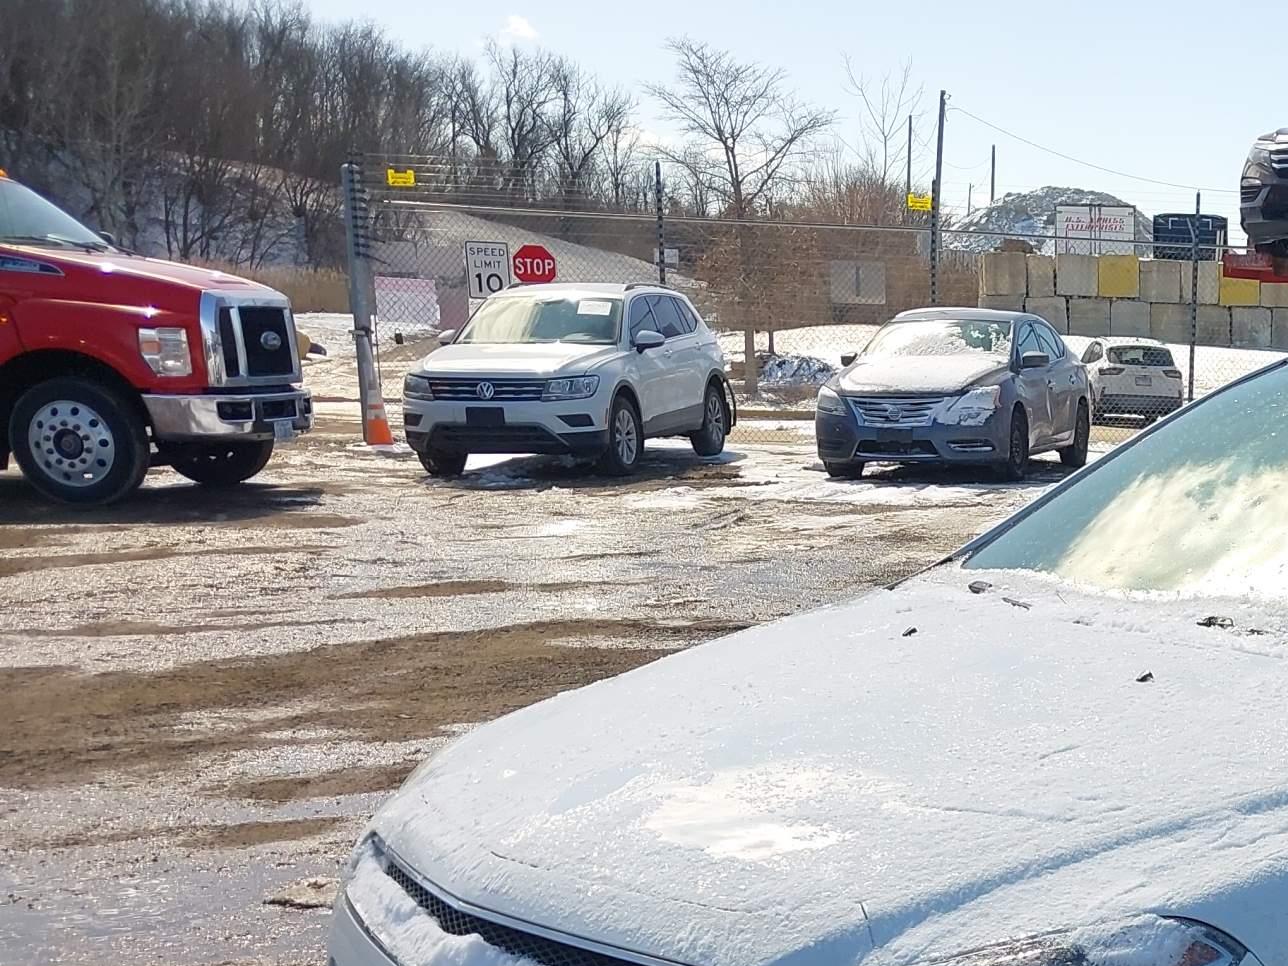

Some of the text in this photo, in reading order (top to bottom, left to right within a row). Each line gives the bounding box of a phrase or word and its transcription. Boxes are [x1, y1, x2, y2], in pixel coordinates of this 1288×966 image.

[469, 247, 505, 257] SPEED
[473, 259, 502, 269] LIMIT
[515, 257, 554, 275] STOP
[475, 273, 503, 293] 10
